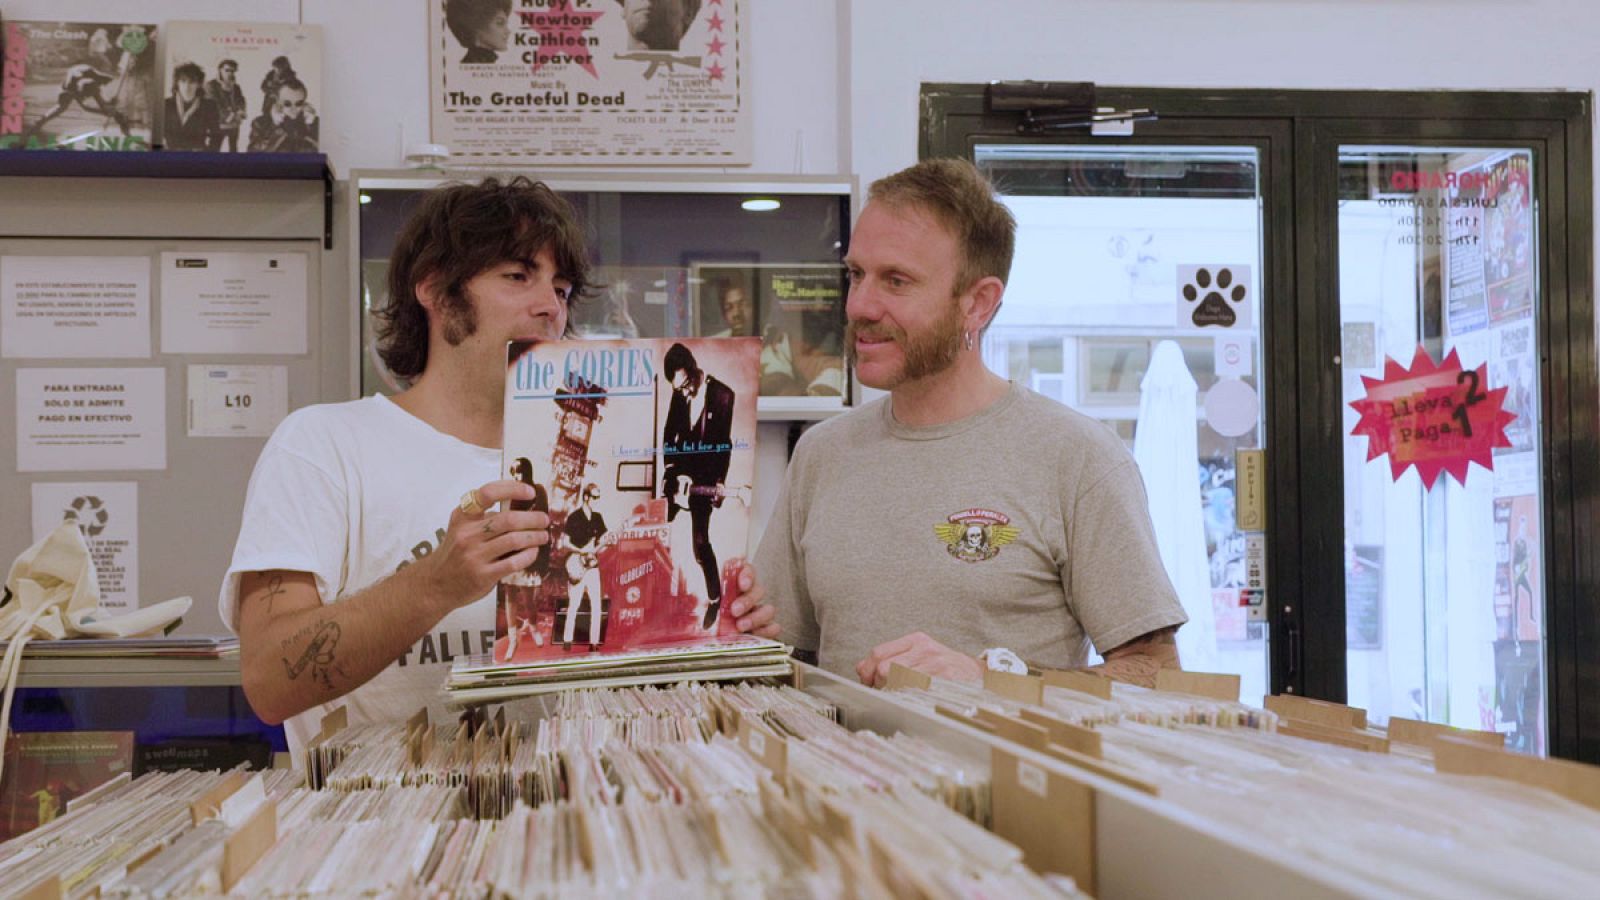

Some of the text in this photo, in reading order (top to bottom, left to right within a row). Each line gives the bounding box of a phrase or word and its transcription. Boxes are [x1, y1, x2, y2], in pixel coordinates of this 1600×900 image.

[521, 13, 593, 25] Newton
[54, 29, 88, 39] Clash
[515, 33, 599, 46] Kathleen
[521, 51, 593, 64] Cleaver
[1, 22, 28, 133] LONDON
[448, 92, 625, 105] The Grateful Dead
[516, 348, 653, 391] the GORIES
[44, 384, 125, 392] PARA ENTRADAS
[1458, 370, 1487, 405] 2
[225, 395, 252, 407] L10
[1452, 403, 1472, 437] 1
